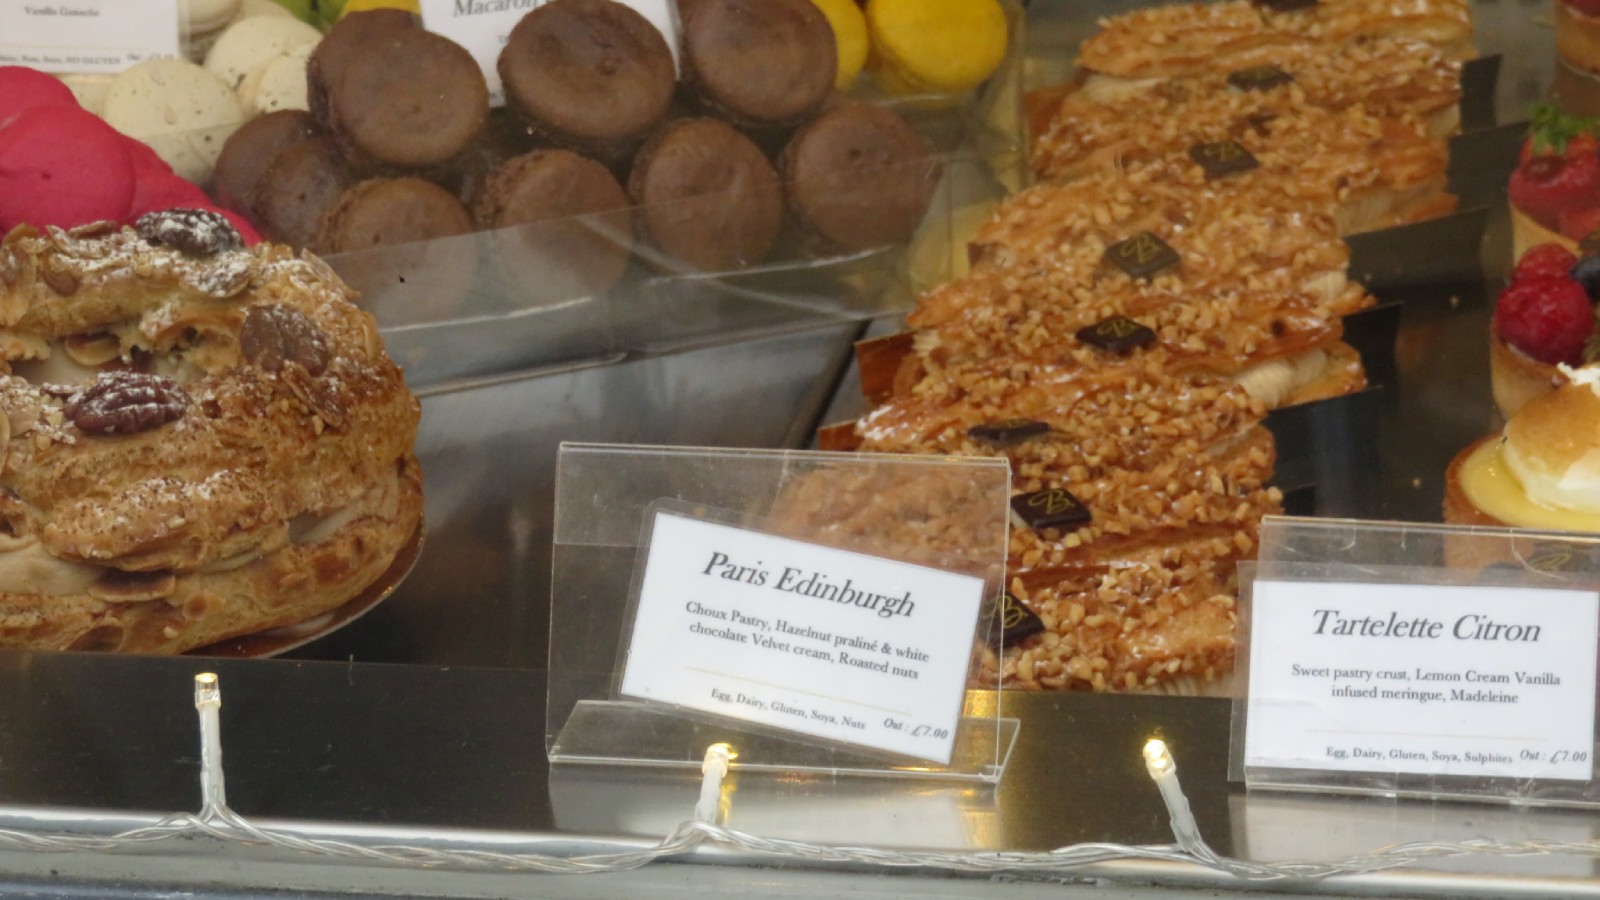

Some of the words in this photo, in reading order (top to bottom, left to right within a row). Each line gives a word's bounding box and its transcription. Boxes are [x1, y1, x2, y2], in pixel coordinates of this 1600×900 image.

[702, 551, 769, 587] Paris
[773, 566, 916, 619] Edinburgh
[685, 601, 727, 621] Choux
[731, 610, 772, 631] Pastry,
[775, 620, 832, 643] Hazelnut
[834, 633, 878, 652] praliné
[881, 642, 893, 655] &
[895, 646, 930, 663] white
[1313, 609, 1444, 640] Tartelette
[1452, 614, 1542, 643] Citron
[689, 621, 748, 644] chocolate
[752, 632, 790, 652] Velvet
[793, 646, 834, 664] cream,
[838, 651, 889, 673] Roasted
[891, 666, 919, 679] nuts
[1292, 664, 1330, 678] Sweet
[1333, 669, 1373, 681] pastry
[1376, 670, 1411, 682] crust,
[1415, 668, 1461, 682] Lemon
[1465, 670, 1510, 684] Cream
[1514, 671, 1561, 685] Vanilla
[1331, 684, 1378, 699] infused
[1381, 690, 1446, 704] meringue,
[1450, 688, 1519, 704] Madeleine
[711, 688, 734, 704] Egg,
[736, 693, 768, 711] Dairy,
[770, 701, 808, 719] Gluten,
[810, 709, 838, 726] Soya,
[841, 716, 866, 731] Nuts
[910, 725, 948, 741] £7.00
[1326, 746, 1350, 760] Egg,
[1352, 747, 1386, 761] Dairy,
[1388, 749, 1429, 762] Gluten,
[1431, 751, 1461, 764] Soya,
[1464, 751, 1513, 766] Sulphites
[1549, 750, 1588, 765] £7.00
